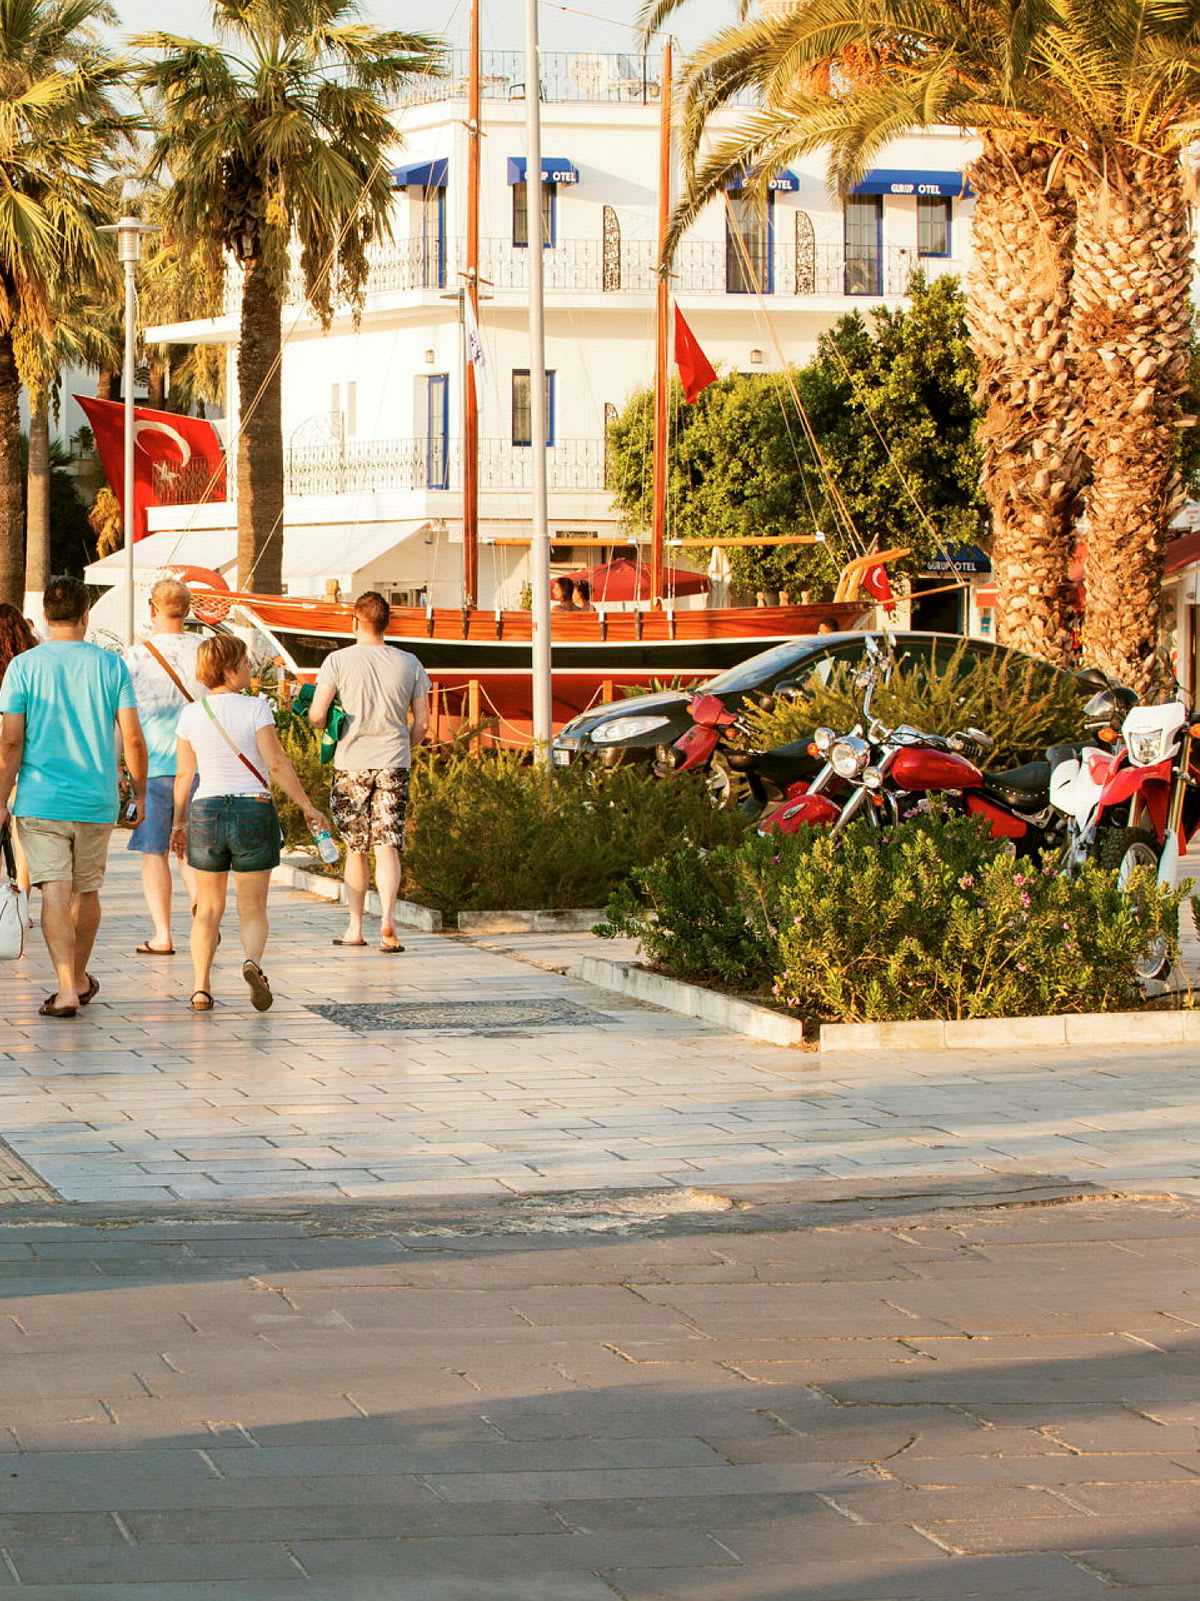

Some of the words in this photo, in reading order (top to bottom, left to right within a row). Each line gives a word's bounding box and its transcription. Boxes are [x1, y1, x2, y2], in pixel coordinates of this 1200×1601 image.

[552, 171, 576, 182] OTEL
[769, 179, 793, 190] OTEL
[917, 184, 941, 194] OTEL
[954, 561, 976, 571] OTEL
